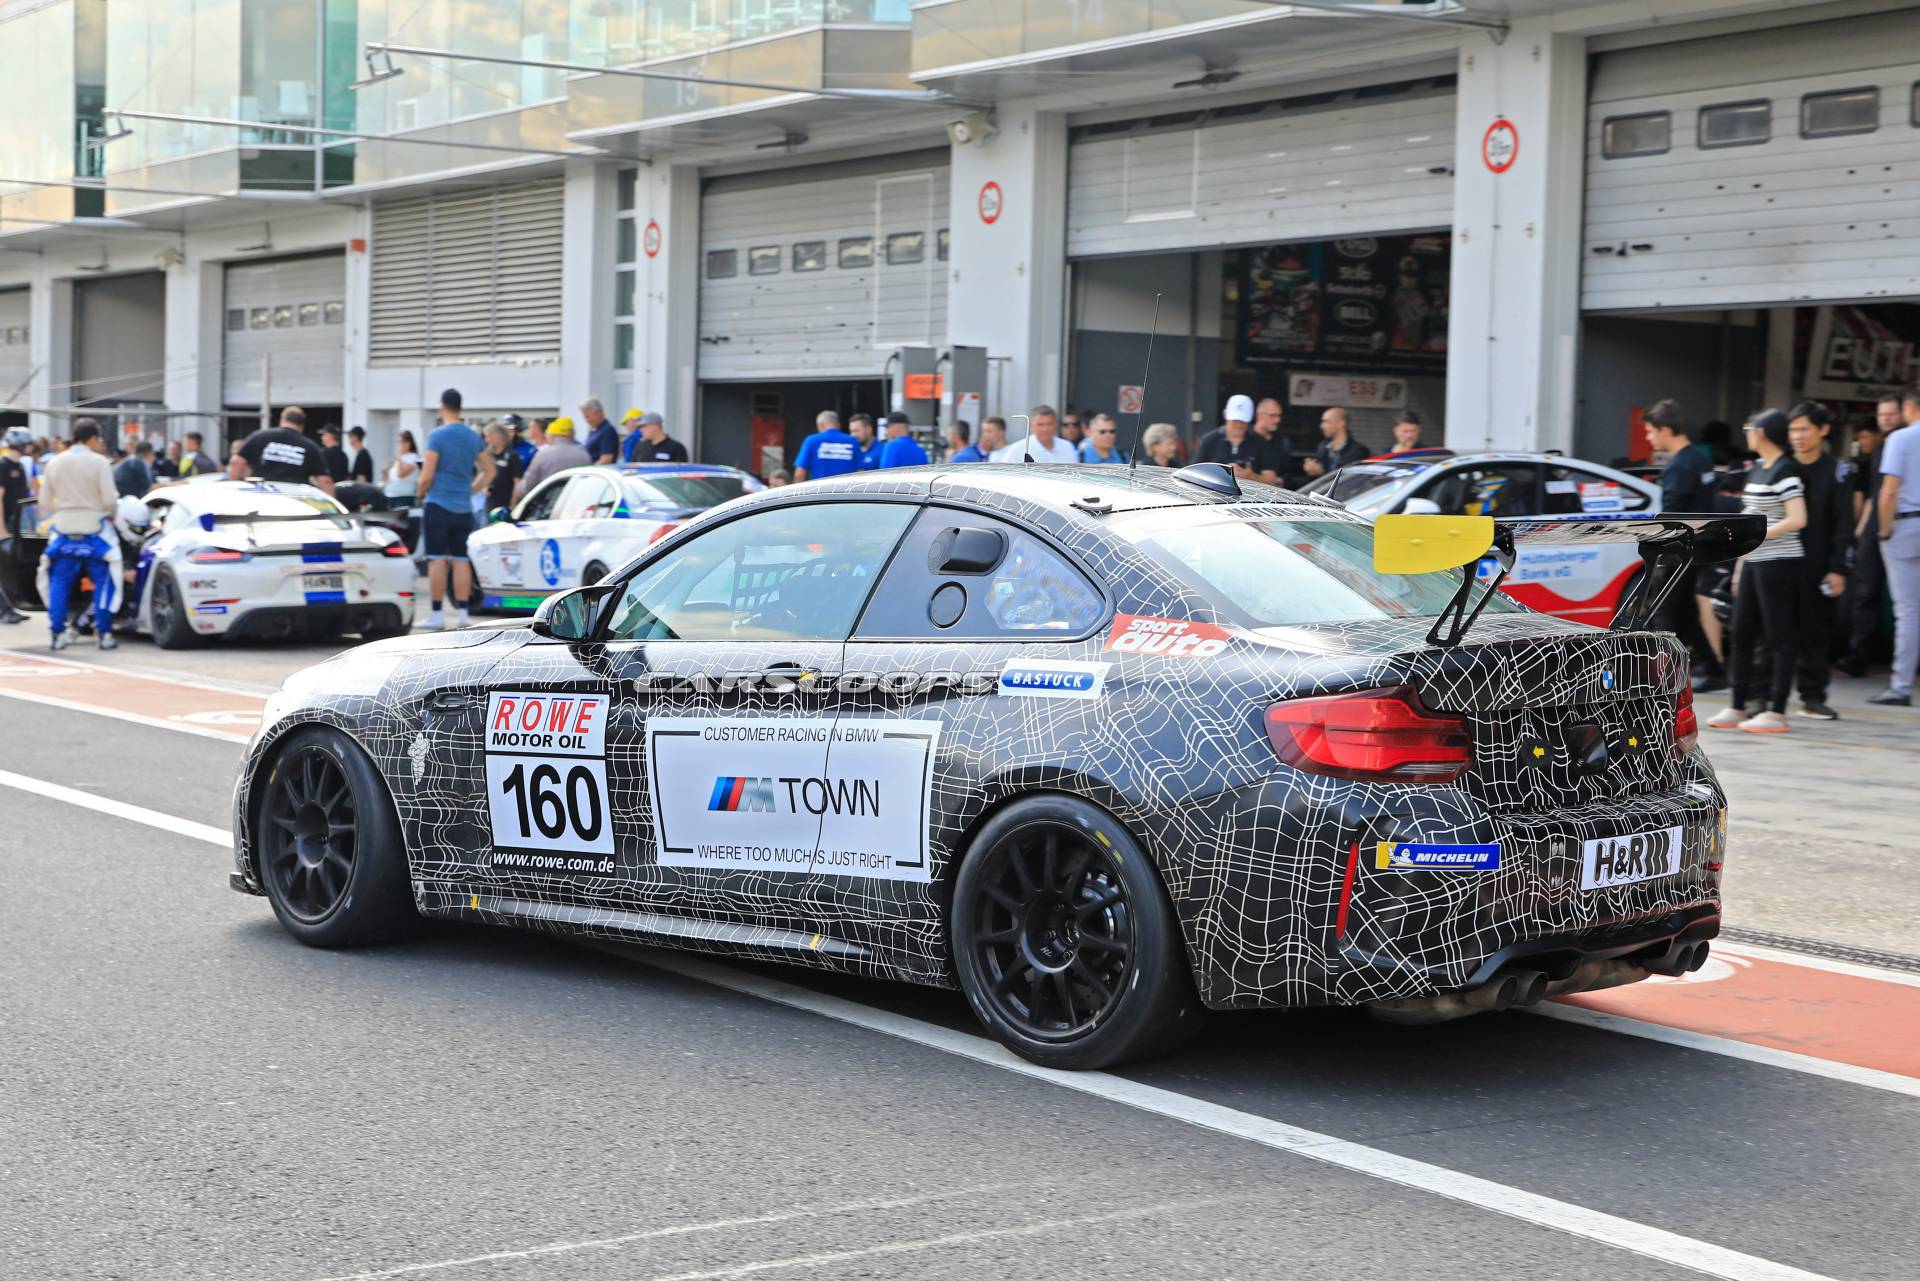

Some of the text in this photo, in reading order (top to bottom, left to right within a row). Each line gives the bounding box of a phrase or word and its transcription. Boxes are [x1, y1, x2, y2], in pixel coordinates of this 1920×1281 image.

[1519, 567, 1551, 580] Bank
[1126, 618, 1190, 634] sport
[1111, 632, 1228, 657] auto
[1012, 671, 1085, 688] BASTUCK
[494, 698, 597, 733] ROWE
[492, 732, 586, 749] MOTOR OIL
[704, 726, 775, 742] CUSTOMER
[777, 727, 826, 742] RACING
[845, 728, 880, 743] BMW
[502, 763, 602, 841] 160
[778, 777, 880, 818] TOWN
[494, 851, 615, 874] www.rowe.com.de
[698, 844, 892, 870] WHERE TOO MUCH IS JUST RIGHT
[1415, 852, 1489, 864] MICHELIN
[1594, 836, 1645, 884] H&R
